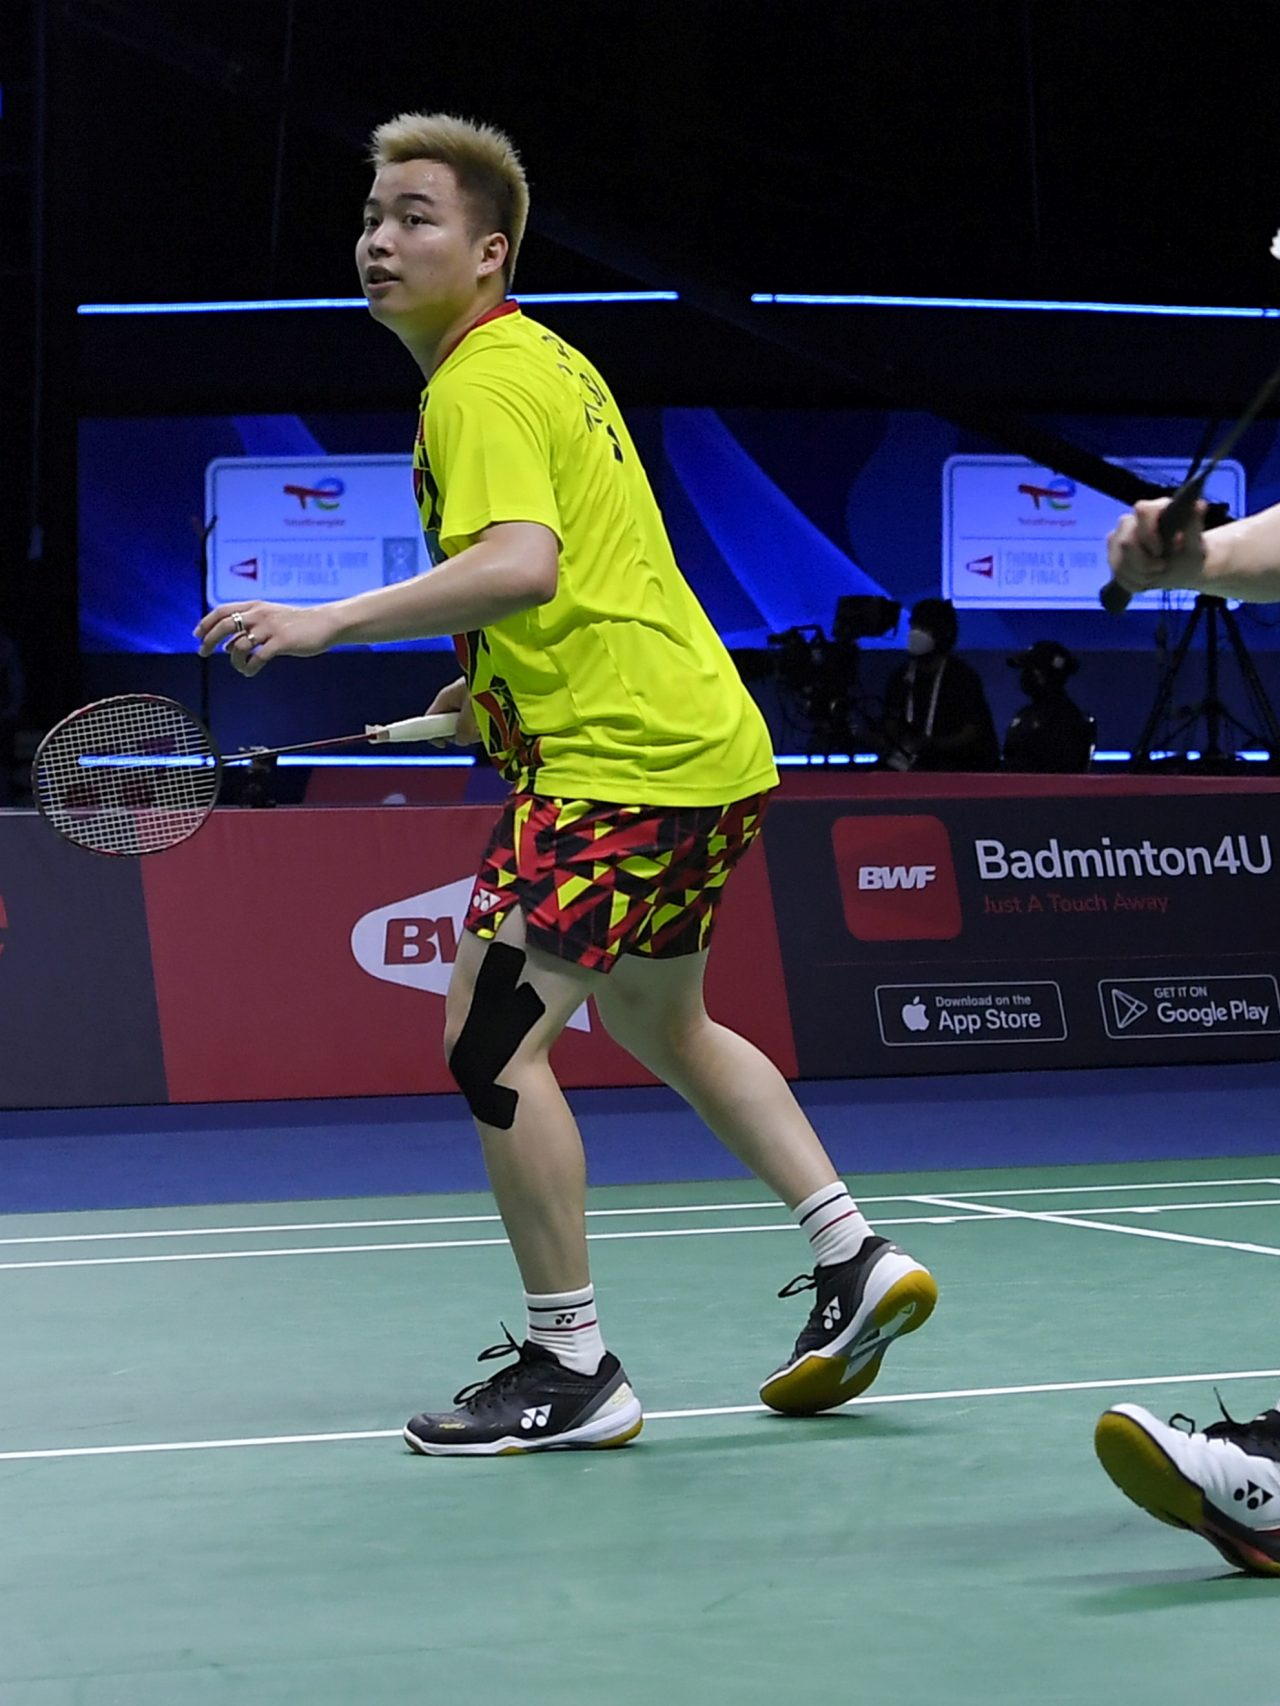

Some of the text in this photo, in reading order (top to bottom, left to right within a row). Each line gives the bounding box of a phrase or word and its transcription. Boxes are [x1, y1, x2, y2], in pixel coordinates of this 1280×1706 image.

[974, 835, 1273, 881] Badminton4U
[858, 865, 937, 890] BWF
[984, 892, 1169, 914] Just A Touch Away
[935, 994, 1031, 1007] Download on the
[1154, 986, 1208, 997] GET IT ON
[938, 1008, 1042, 1034] App Store
[1157, 1000, 1270, 1027] Google Play
